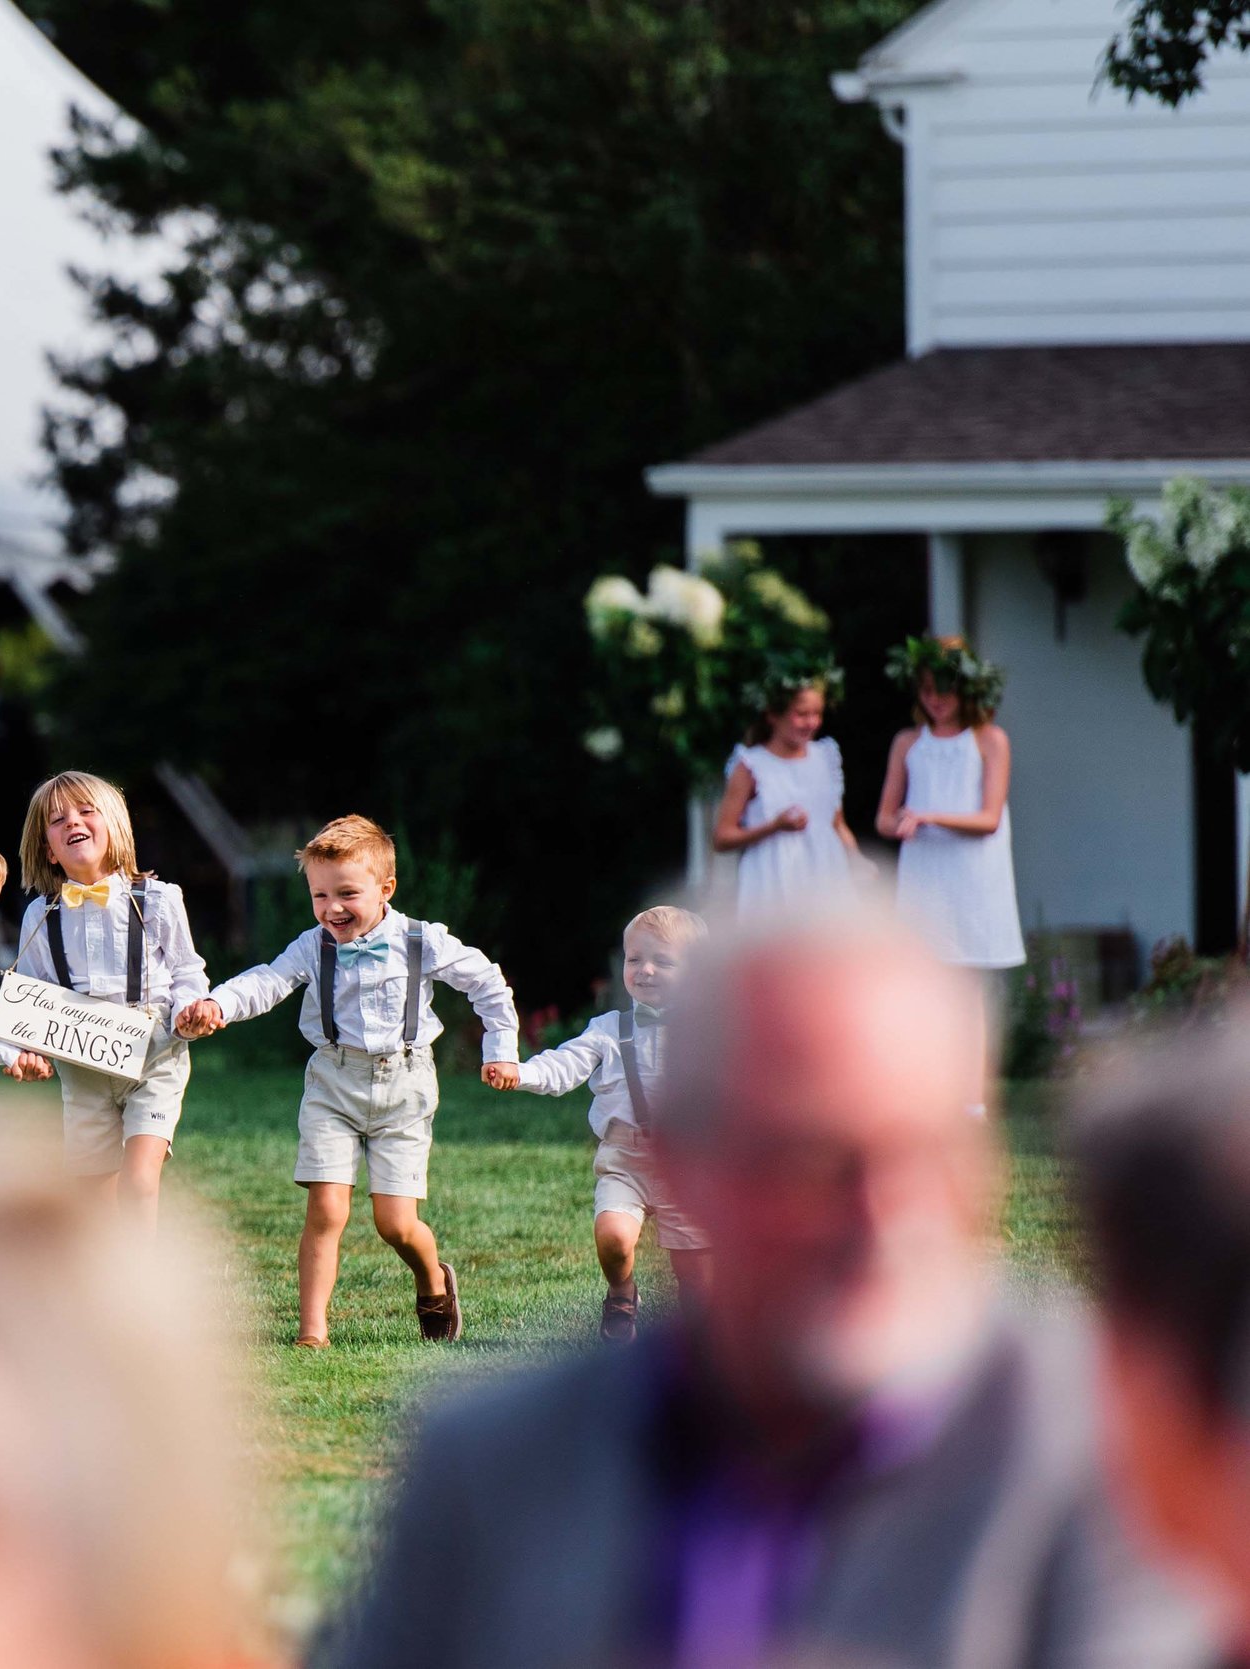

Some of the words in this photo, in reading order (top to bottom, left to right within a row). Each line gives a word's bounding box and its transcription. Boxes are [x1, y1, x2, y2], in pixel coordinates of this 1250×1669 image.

[3, 983, 56, 1011] Has
[60, 1004, 114, 1028] anyone
[116, 1021, 147, 1039] seen
[10, 1021, 37, 1040] the
[42, 1019, 133, 1070] RINGS?
